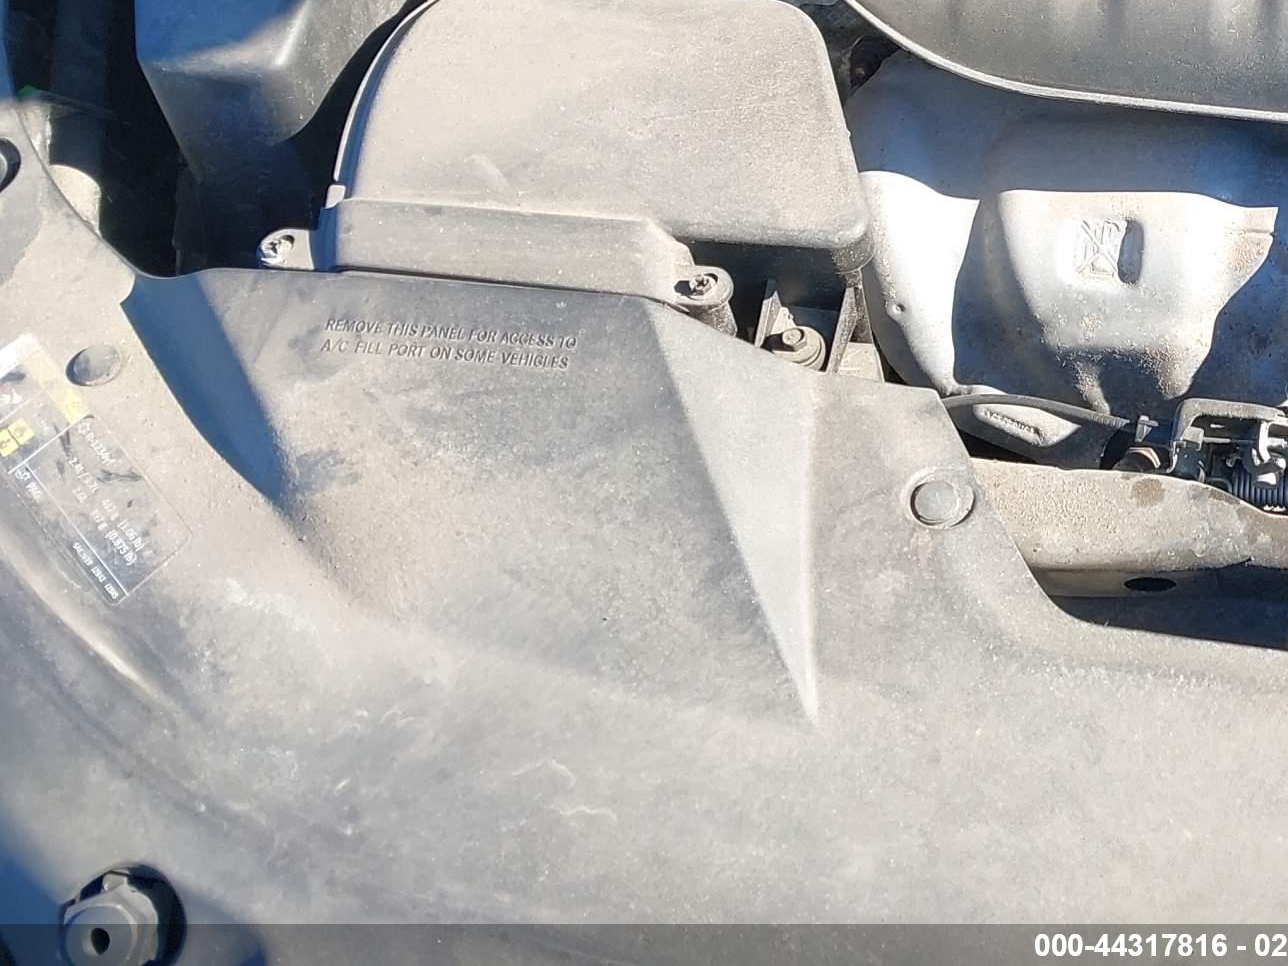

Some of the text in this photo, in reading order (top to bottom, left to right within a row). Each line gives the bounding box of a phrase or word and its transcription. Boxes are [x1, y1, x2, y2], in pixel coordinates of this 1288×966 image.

[324, 318, 577, 349] REMOVE THIS PANEL FOR ACCESS TO
[321, 339, 569, 369] A/C FILL PORT ON SOME VEHICLES
